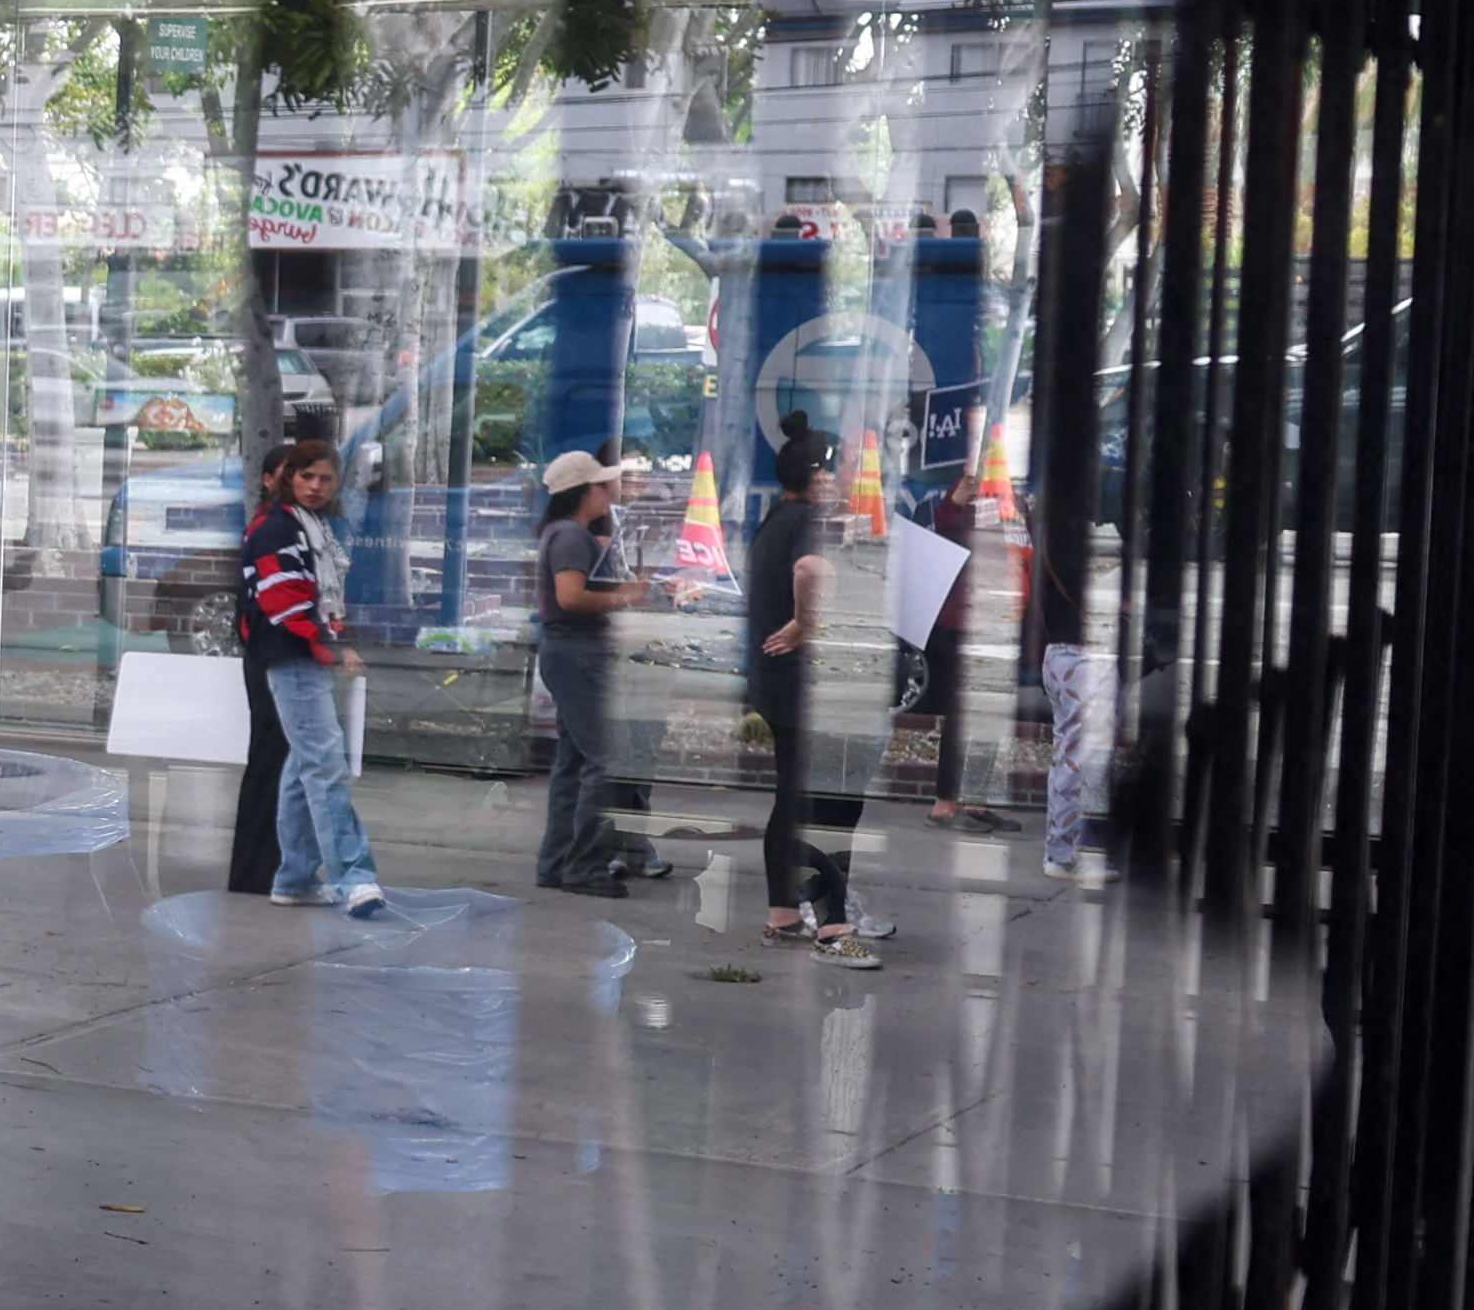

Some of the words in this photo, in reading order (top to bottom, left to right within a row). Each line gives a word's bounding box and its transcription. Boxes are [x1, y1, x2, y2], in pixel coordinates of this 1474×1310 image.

[159, 23, 196, 39] SUPERVISE
[150, 46, 170, 60] YOUR
[171, 47, 204, 62] CHILDREN
